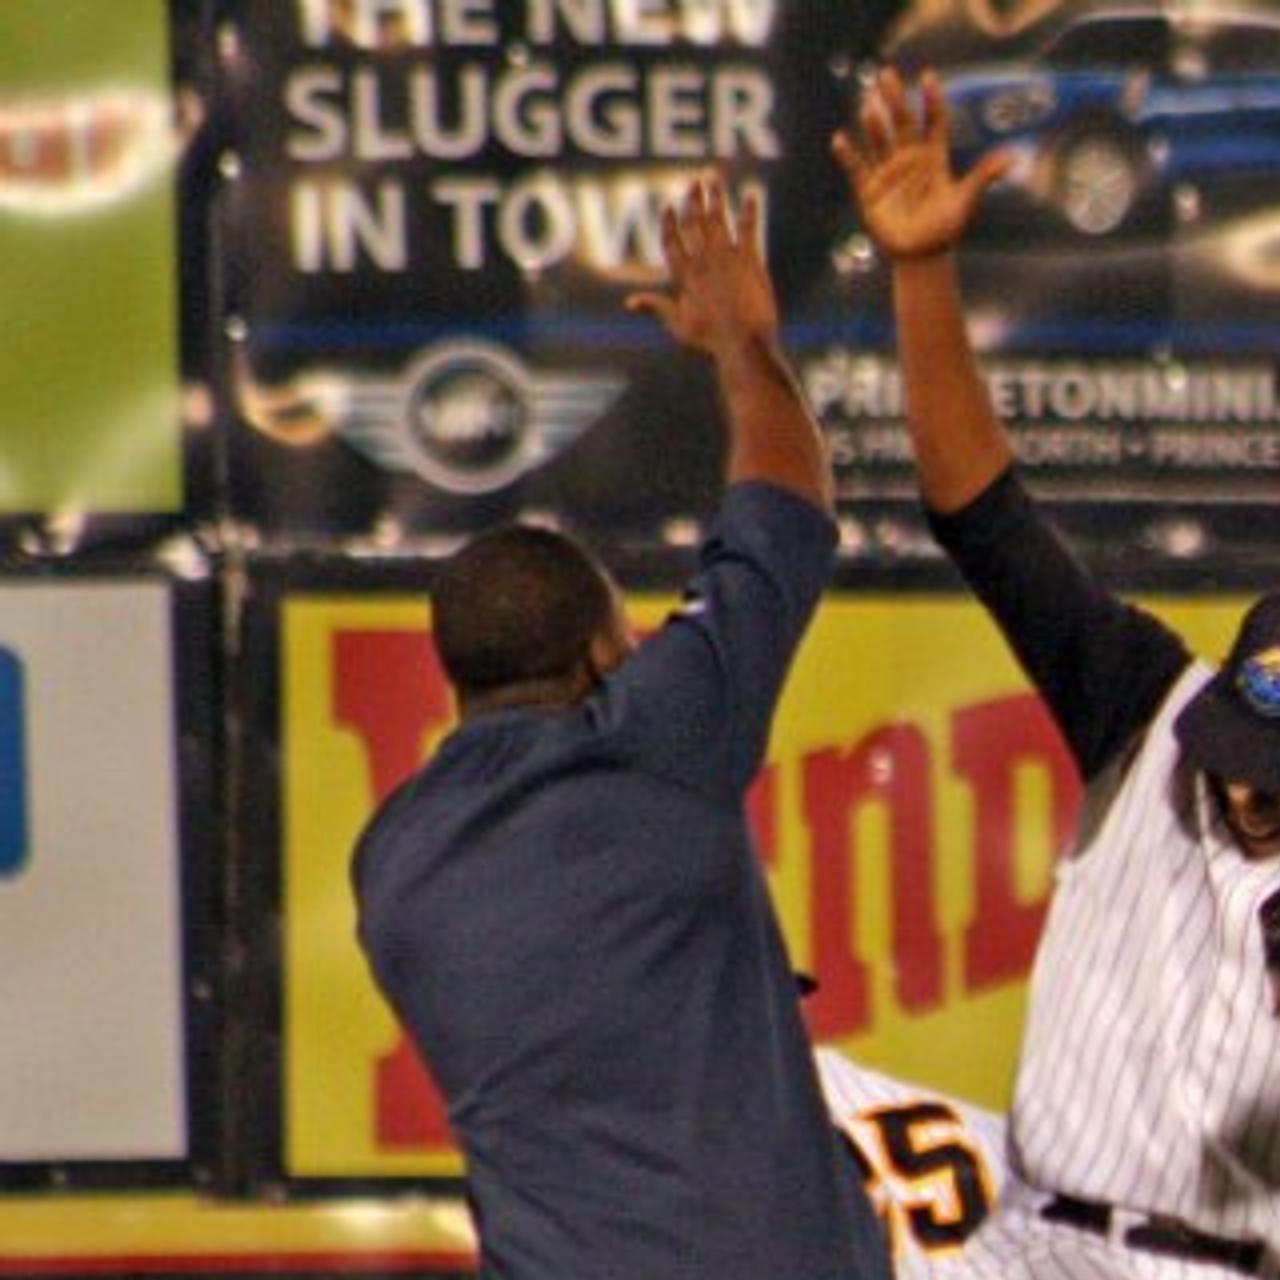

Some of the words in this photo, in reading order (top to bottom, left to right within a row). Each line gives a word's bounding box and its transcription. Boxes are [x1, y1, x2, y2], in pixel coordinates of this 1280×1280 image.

[302, 0, 500, 48] THE
[528, 0, 776, 46] NEW
[286, 66, 782, 160] SLUGGER
[296, 182, 408, 273] IN
[1008, 432, 1122, 464] ORTH
[832, 1102, 988, 1252] 5
